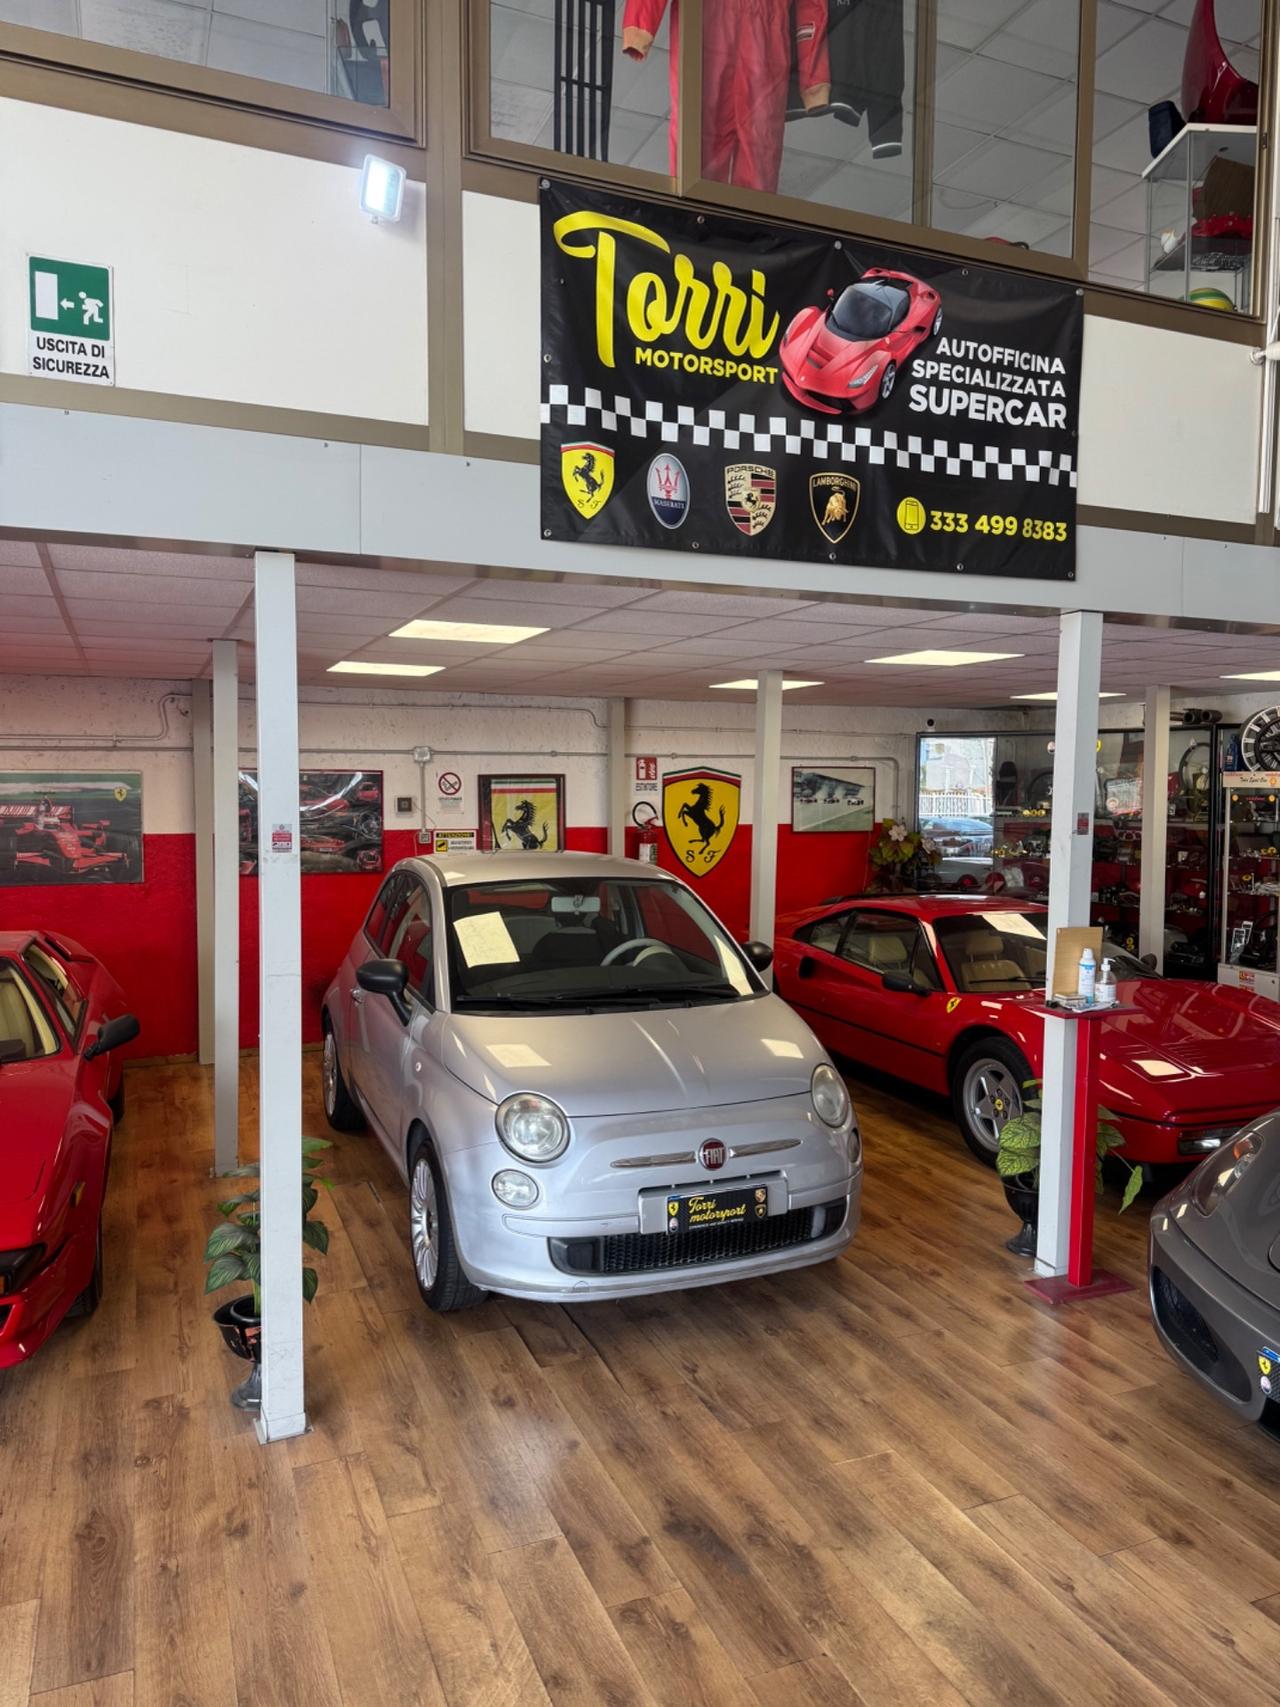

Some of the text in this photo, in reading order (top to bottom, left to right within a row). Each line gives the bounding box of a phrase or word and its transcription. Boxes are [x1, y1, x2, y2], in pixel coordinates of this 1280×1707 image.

[553, 210, 780, 368] Torri
[36, 336, 104, 358] USCITA DI
[936, 337, 1066, 375] AUTOFFICINA
[33, 356, 110, 379] SICUREZZA
[635, 347, 778, 384] MOTORSPORT
[911, 359, 1066, 398] SPECIALIZZATA
[908, 384, 1067, 429] SUPERCAR
[726, 464, 775, 478] PORSCHE
[813, 476, 857, 491] LAMBORGHINI
[930, 510, 1067, 541] 333 499 8383
[685, 850, 696, 863] S
[704, 1146, 725, 1165] FIAT
